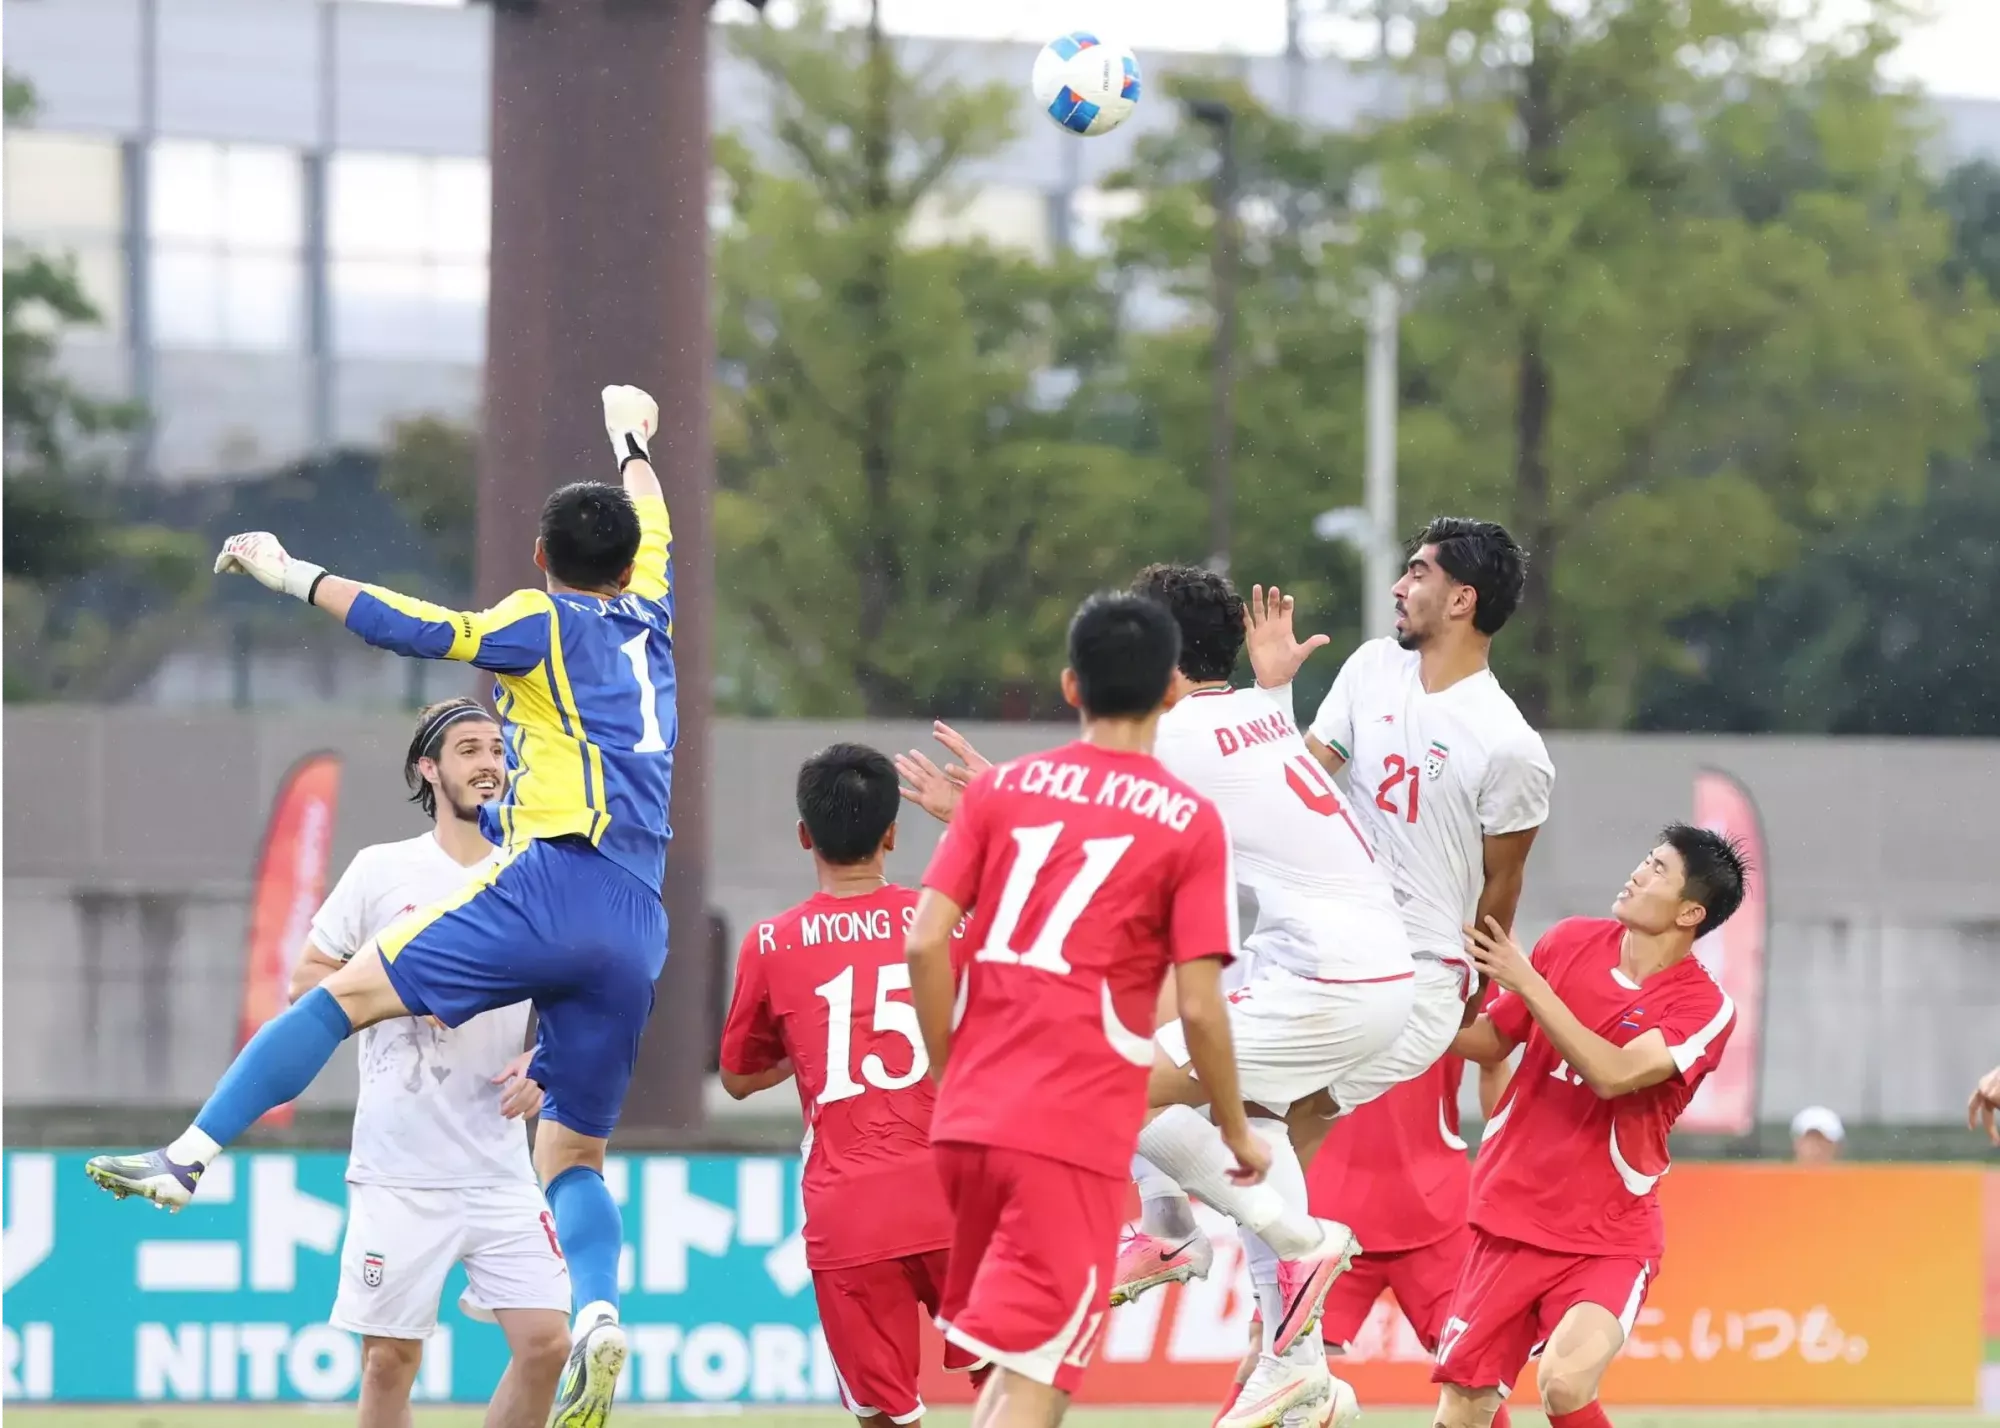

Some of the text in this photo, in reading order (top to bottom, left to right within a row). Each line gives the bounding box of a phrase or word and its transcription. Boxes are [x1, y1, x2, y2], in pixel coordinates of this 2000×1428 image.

[620, 628, 667, 753] 1
[1019, 759, 1091, 805] CHOL
[1094, 770, 1198, 833] KYONG
[1375, 753, 1420, 824] 21
[801, 909, 892, 947] MYONG
[976, 821, 1135, 976] 11
[815, 963, 931, 1104] 15
[134, 1321, 453, 1400] NITOI
